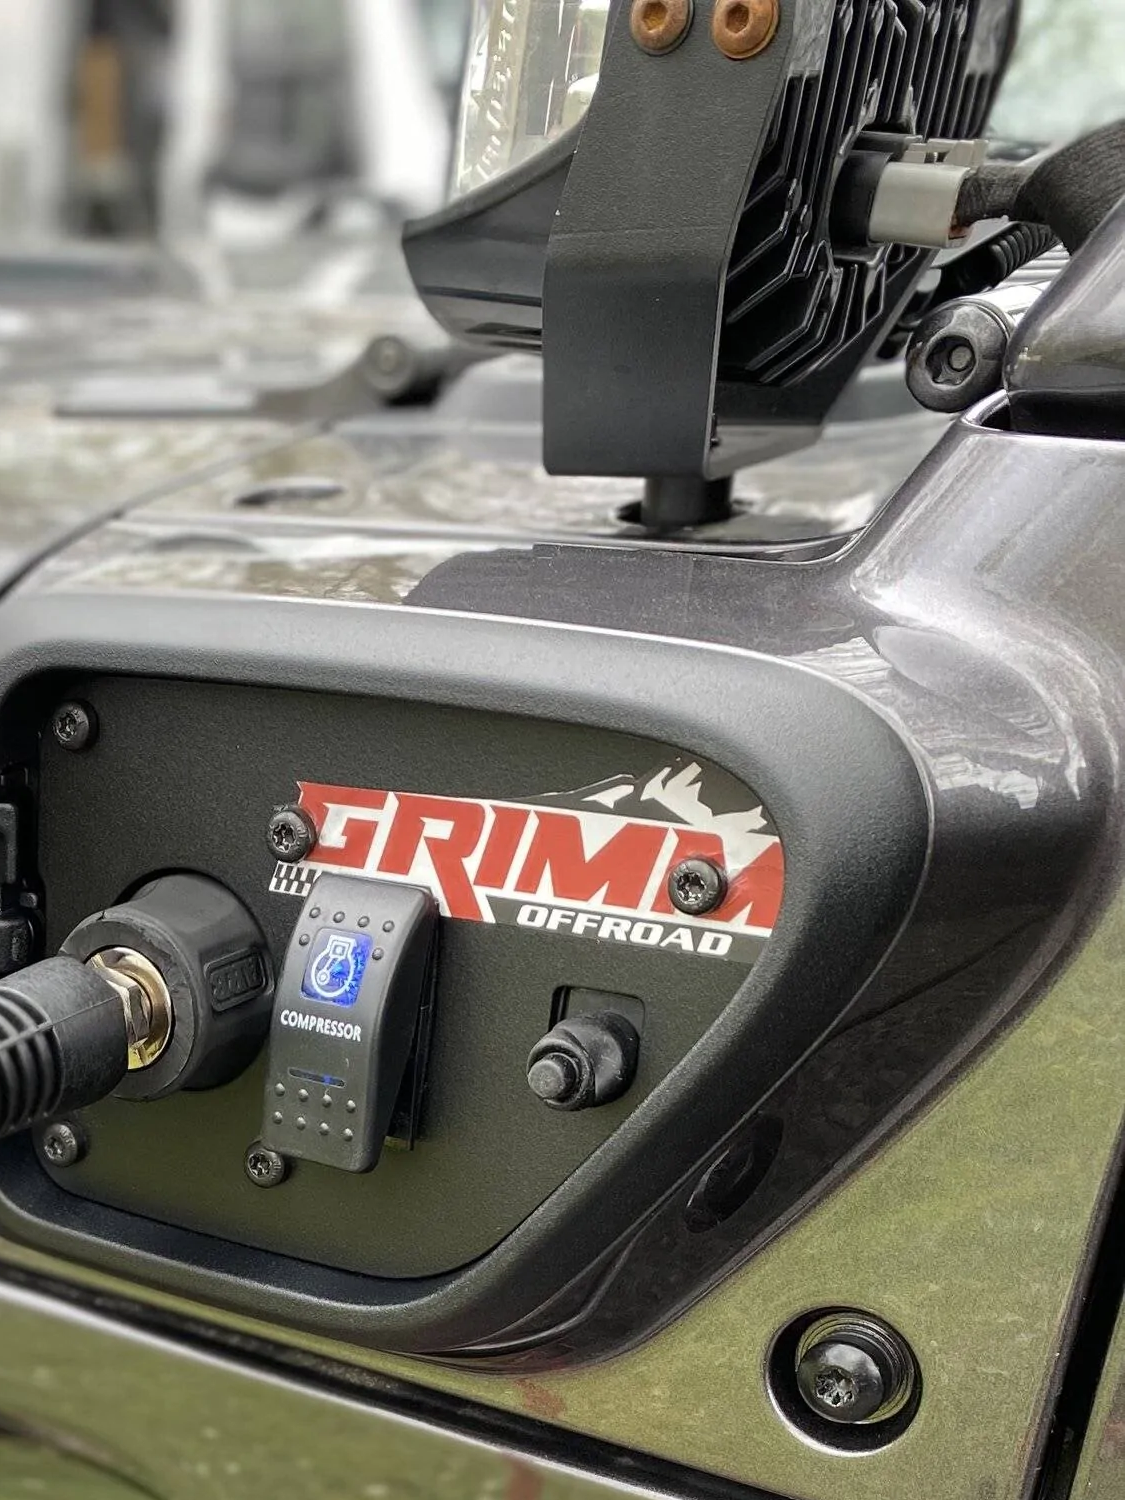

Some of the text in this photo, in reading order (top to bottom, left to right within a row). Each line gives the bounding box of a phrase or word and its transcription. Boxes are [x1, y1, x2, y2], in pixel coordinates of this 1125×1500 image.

[295, 781, 784, 930] GRIMM
[516, 904, 733, 956] OFFROAD
[280, 1009, 362, 1042] COMPRESSOR
